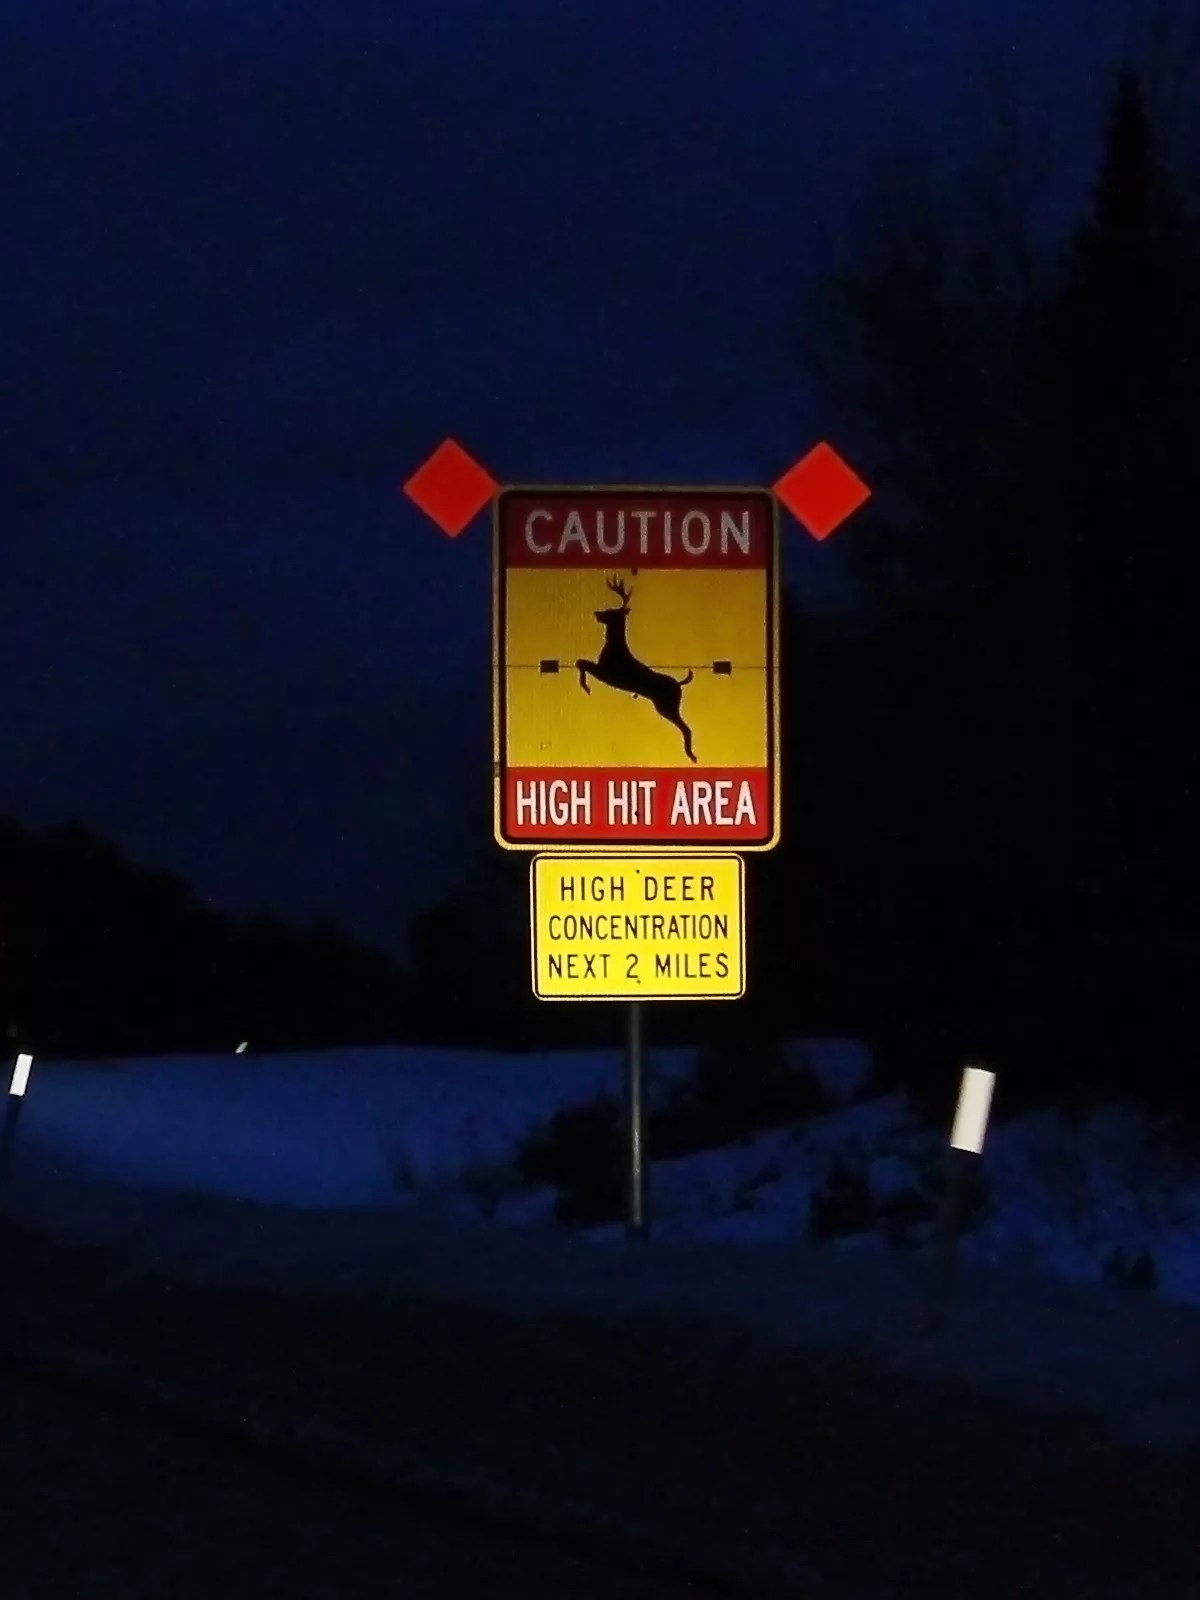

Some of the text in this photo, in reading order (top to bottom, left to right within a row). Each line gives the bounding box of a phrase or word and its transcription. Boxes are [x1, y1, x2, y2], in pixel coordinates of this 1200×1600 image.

[524, 510, 752, 555] CAUTION
[516, 780, 757, 825] HIGH HIT AREA
[560, 876, 715, 901] HIGH DEER
[548, 915, 729, 941] CONCENTRATION
[548, 953, 729, 980] NEXT 2 MILES
